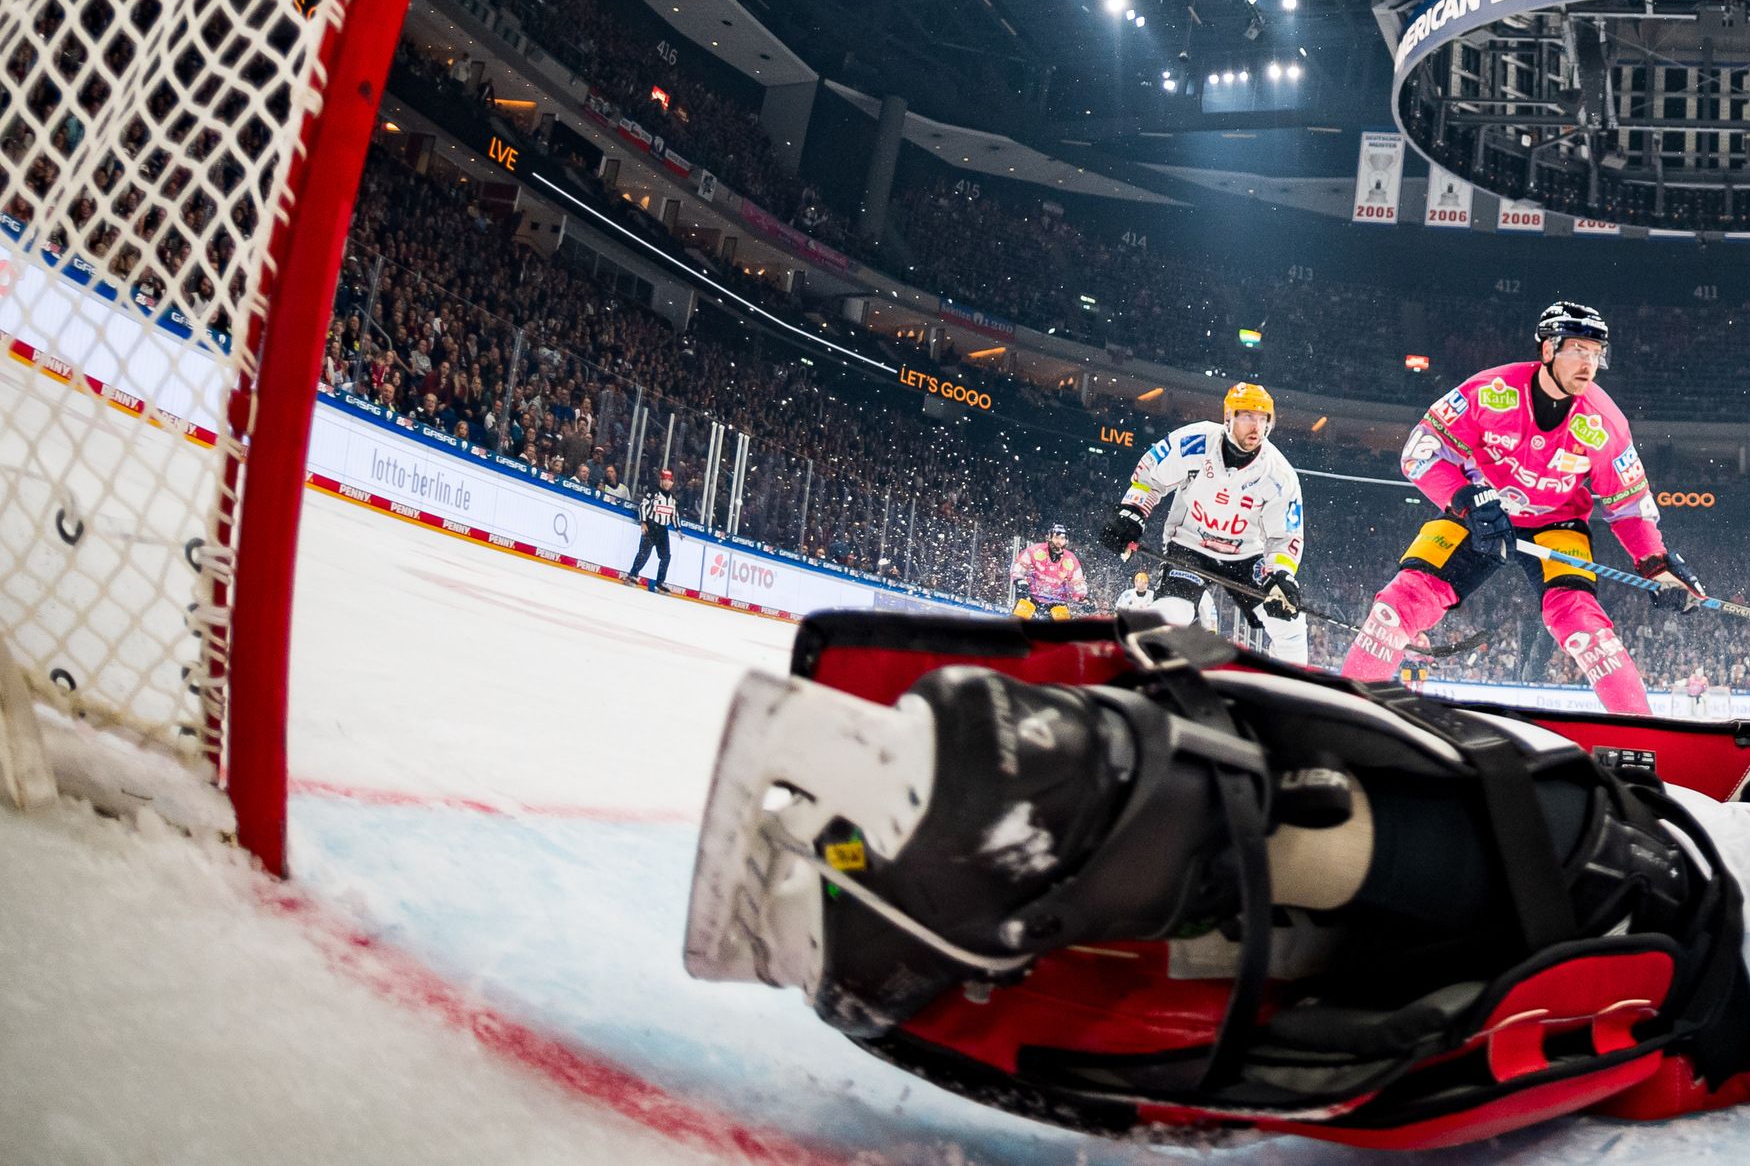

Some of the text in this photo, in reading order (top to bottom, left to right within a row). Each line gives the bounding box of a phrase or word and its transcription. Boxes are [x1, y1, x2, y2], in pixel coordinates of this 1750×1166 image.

[656, 40, 678, 66] 416
[955, 179, 981, 199] 415
[1356, 205, 1395, 219] 2005
[1428, 209, 1468, 223] 2006
[1502, 213, 1541, 226] 2008
[1121, 231, 1147, 248] 414
[1287, 264, 1314, 281] 413
[1495, 278, 1521, 294] 412
[1693, 285, 1719, 300] 411
[899, 366, 992, 411] LET'S GOOO
[345, 394, 382, 416] GASAG
[1482, 390, 1517, 405] Karls
[423, 426, 457, 447] GASAG
[1100, 426, 1134, 447] LIVE
[1571, 419, 1602, 447] Karls
[495, 455, 527, 473] GASAG
[370, 447, 472, 511] lotto-berlin.de
[562, 479, 592, 496] GASAG
[1657, 491, 1716, 508] GOOO
[731, 559, 775, 589] LOTTO
